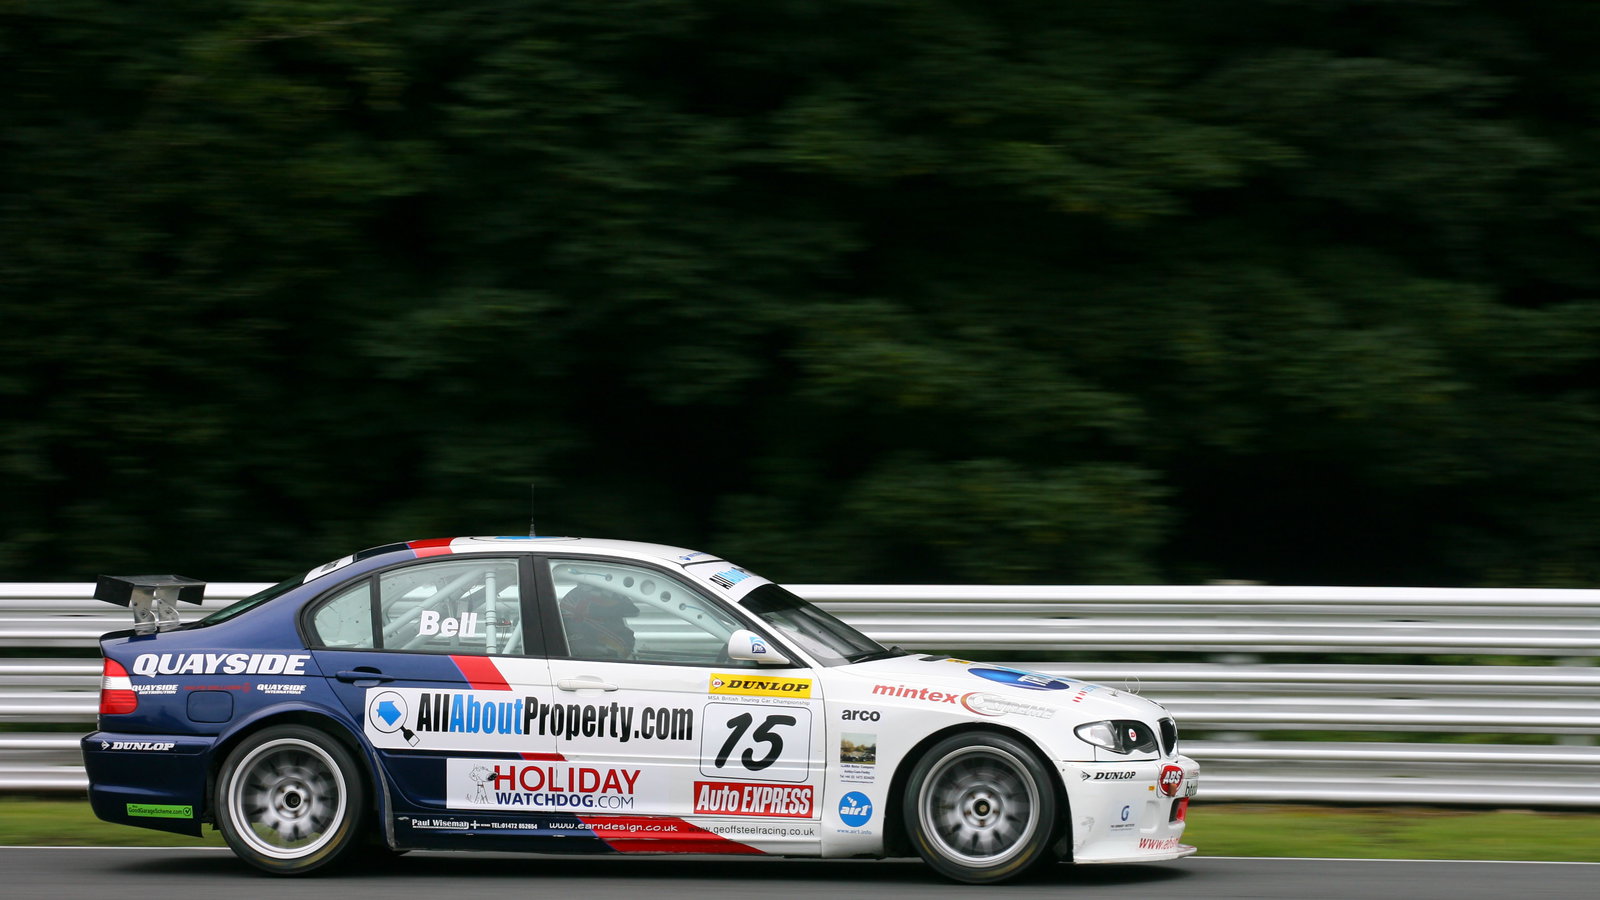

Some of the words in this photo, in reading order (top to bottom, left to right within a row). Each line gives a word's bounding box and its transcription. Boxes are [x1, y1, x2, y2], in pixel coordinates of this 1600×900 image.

[419, 610, 478, 638] Bell
[132, 653, 311, 678] QUAYSIDE
[132, 684, 179, 692] QUAYSIDE
[256, 683, 307, 692] QUAYSIDE
[727, 679, 810, 692] DUNLOP
[740, 696, 760, 704] Touring
[772, 698, 811, 706] Championship
[872, 684, 961, 705] mintex
[416, 693, 693, 742] AllAboutProperty.com
[841, 709, 881, 722] arco
[111, 741, 175, 751] DUNLOP
[714, 712, 797, 772] 15
[494, 764, 641, 794] HOLIDAY
[1093, 771, 1136, 780] DUNLOP
[1162, 770, 1182, 784] ABS
[495, 792, 634, 810] WATCHDOG.COM
[696, 784, 740, 812] Auto
[741, 786, 811, 815] EXPRESS
[840, 804, 869, 816] air1
[411, 819, 430, 827] Paul
[432, 819, 469, 829] Wiseman
[549, 821, 679, 833] www.earndesign.co.uk
[688, 824, 815, 837] www.geoffsteelracing.co.uk
